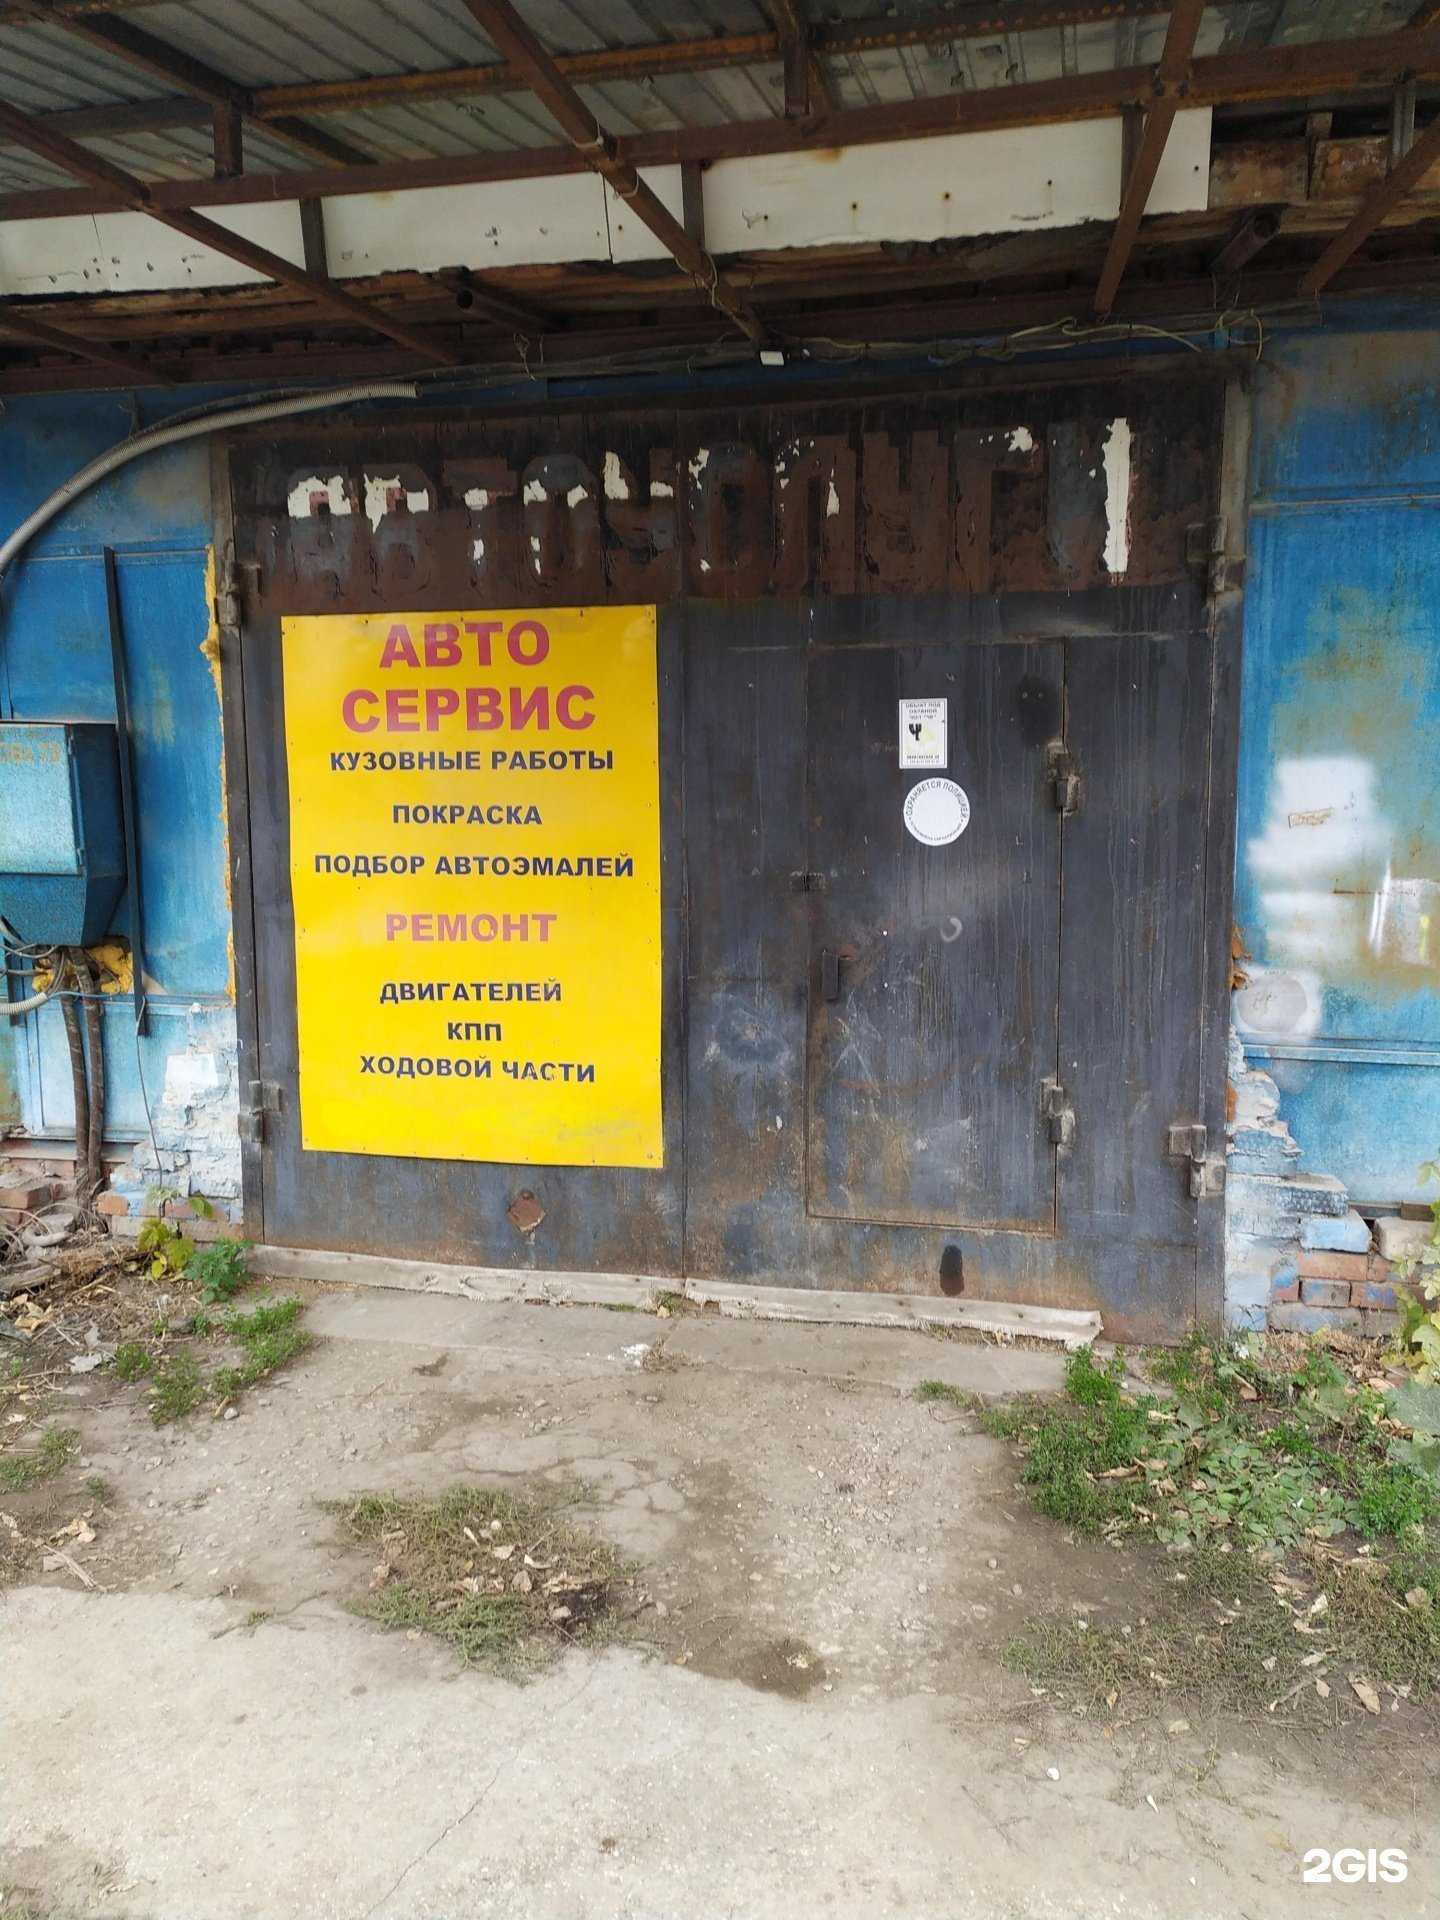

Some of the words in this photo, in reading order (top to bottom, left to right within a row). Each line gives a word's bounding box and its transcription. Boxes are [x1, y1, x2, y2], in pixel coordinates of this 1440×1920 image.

[379, 619, 551, 669] АВТО
[342, 684, 596, 733] СЕРВИС
[330, 750, 481, 772] КУЗОВНЫЕ
[491, 749, 614, 771] РАБОТЫ
[392, 804, 543, 826] ПОКРАСКА
[314, 854, 426, 877] ПОДБОР
[435, 852, 634, 878] АВТОЭМАЛЕЙ
[386, 914, 555, 941] РЕМОНТ
[379, 977, 562, 1004] ДВИГАТЕЛЕЙ
[447, 1022, 502, 1041] КПП
[360, 1055, 492, 1079] ХОДОВОЙ
[502, 1061, 595, 1083] ЧАСТИ
